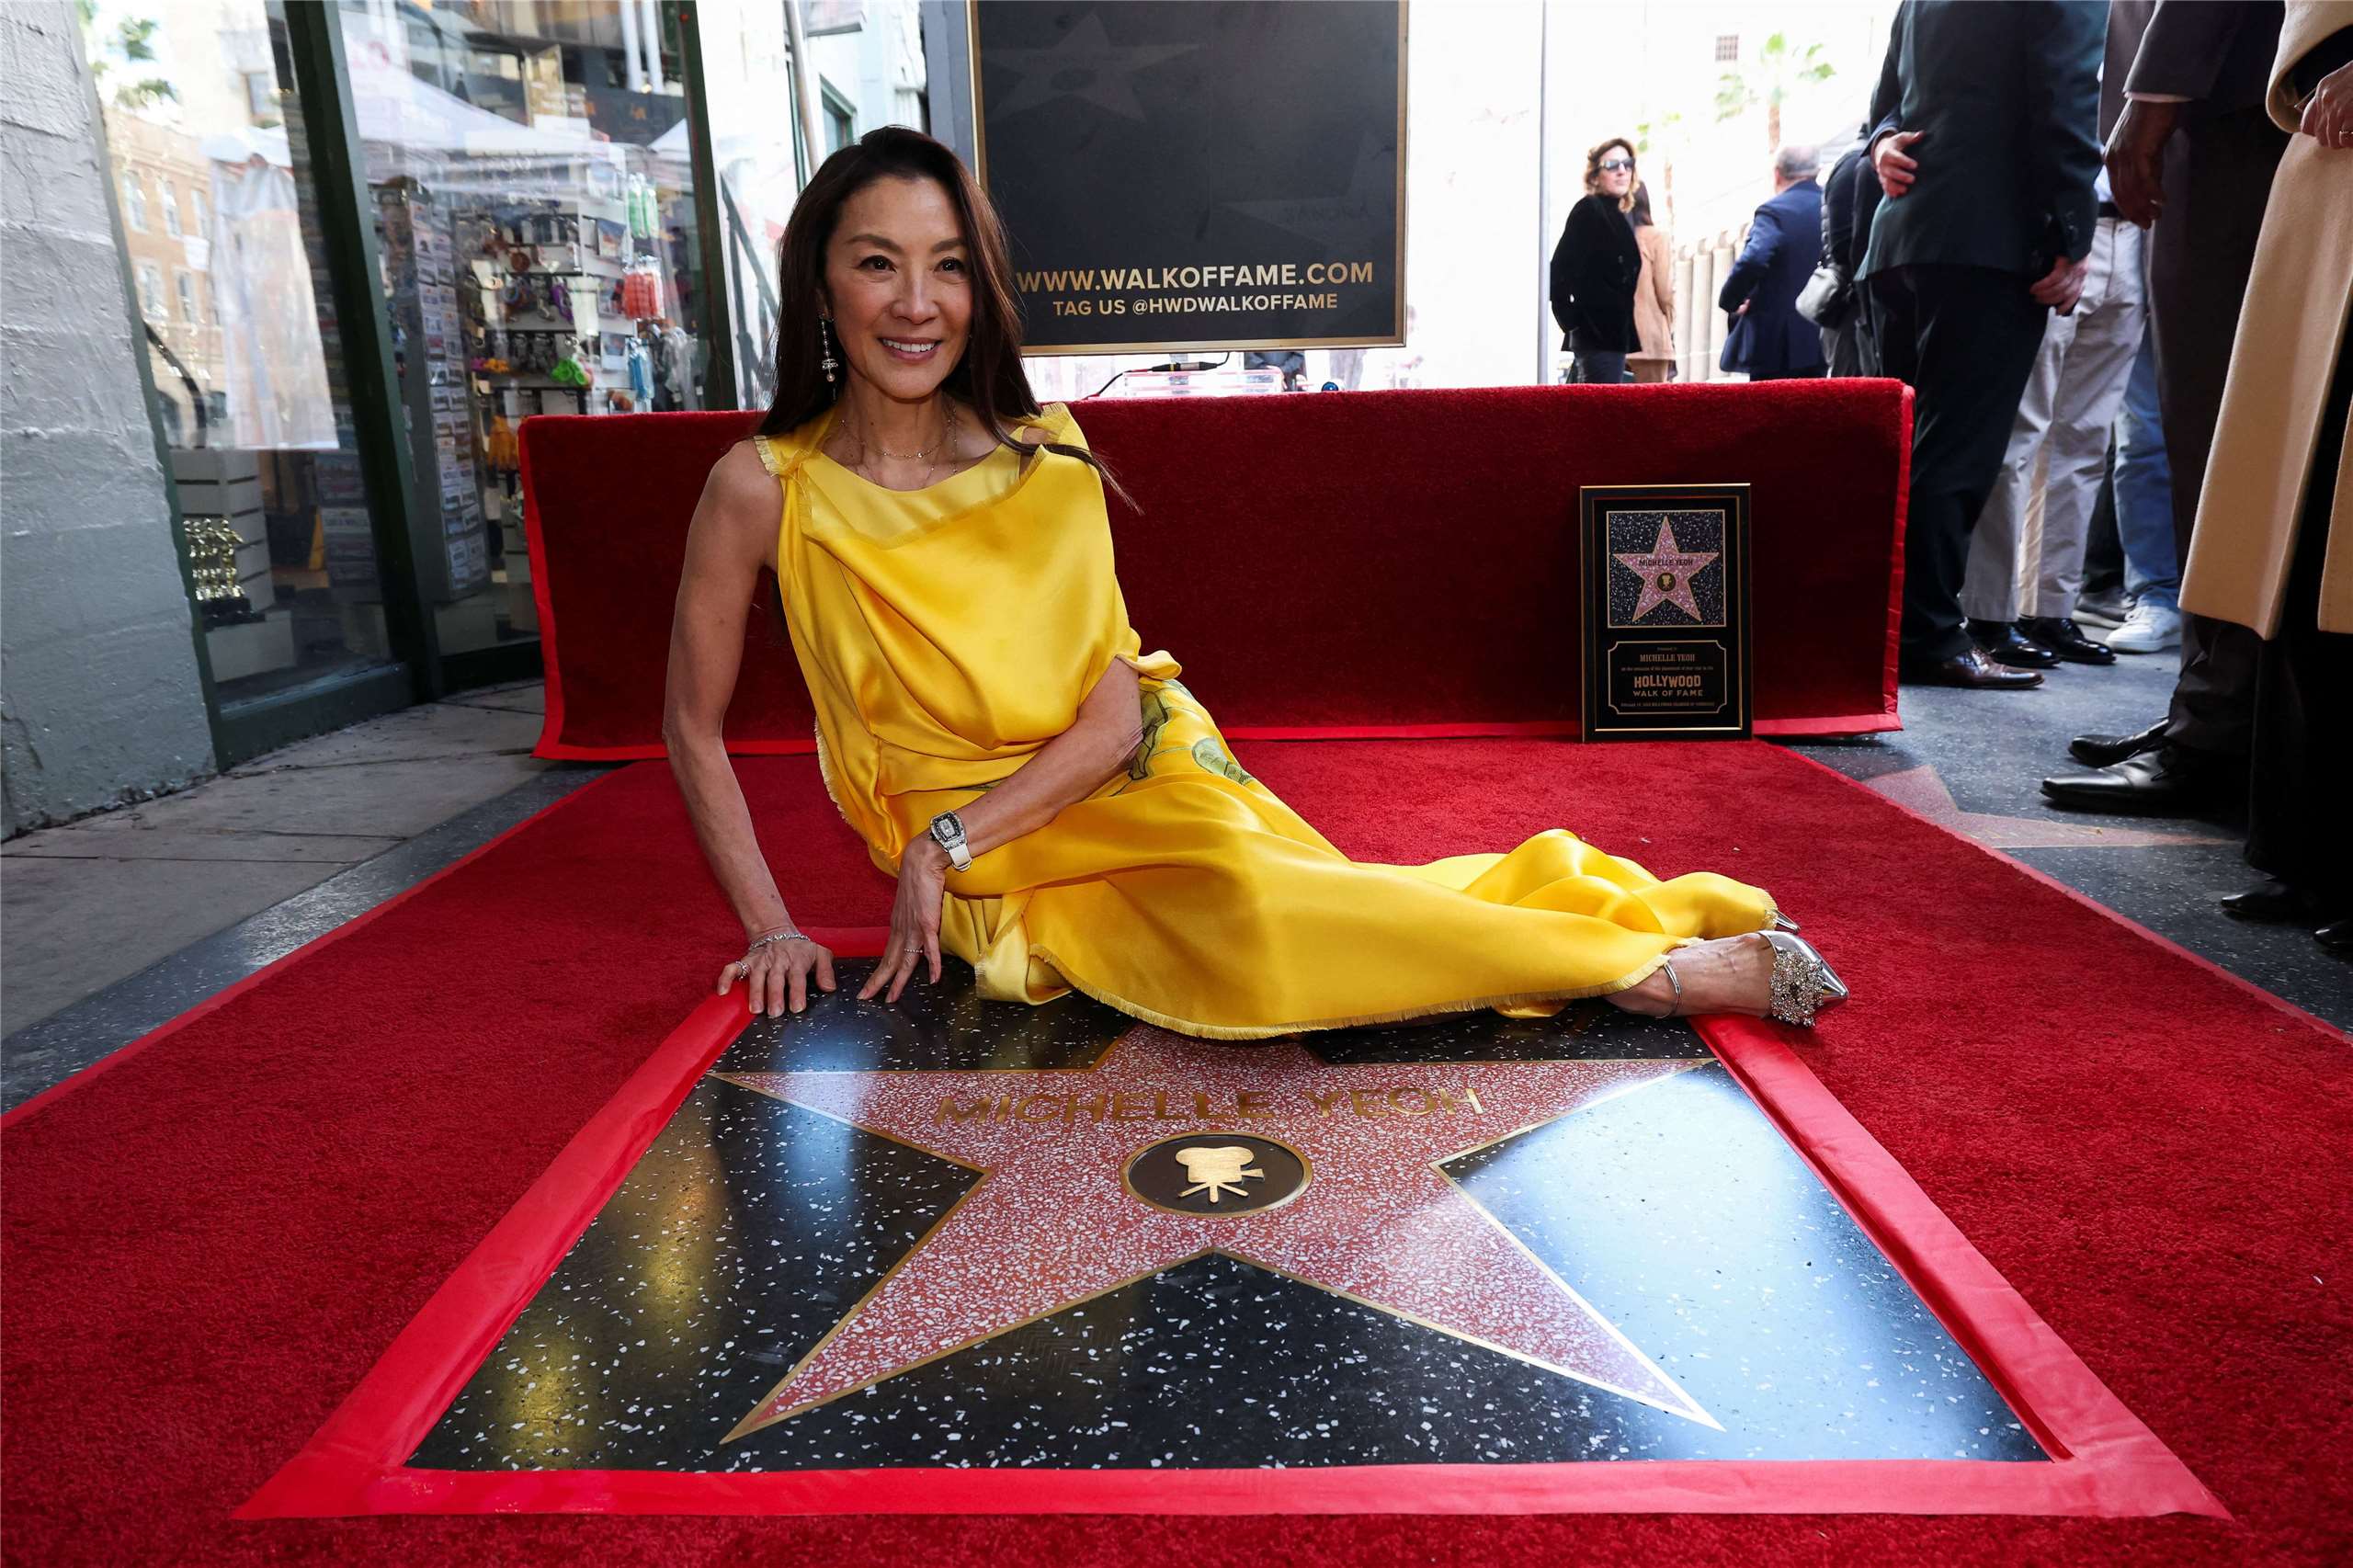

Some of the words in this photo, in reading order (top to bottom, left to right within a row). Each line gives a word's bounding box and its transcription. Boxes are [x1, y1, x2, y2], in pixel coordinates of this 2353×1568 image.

[1016, 261, 1374, 293] WWW.WALKOFFAME.COM
[1052, 301, 1093, 316] TAG
[1098, 299, 1127, 315] US
[1131, 292, 1338, 316] @HWDWALKOFFAME
[1676, 558, 1693, 566] YEOH
[1640, 653, 1676, 662] MICHELLE
[1677, 653, 1696, 662] YEOH
[1633, 675, 1702, 688] HOLLYWOOD
[934, 1090, 1276, 1125] MICHELLE
[1303, 1086, 1485, 1118] YEOH
